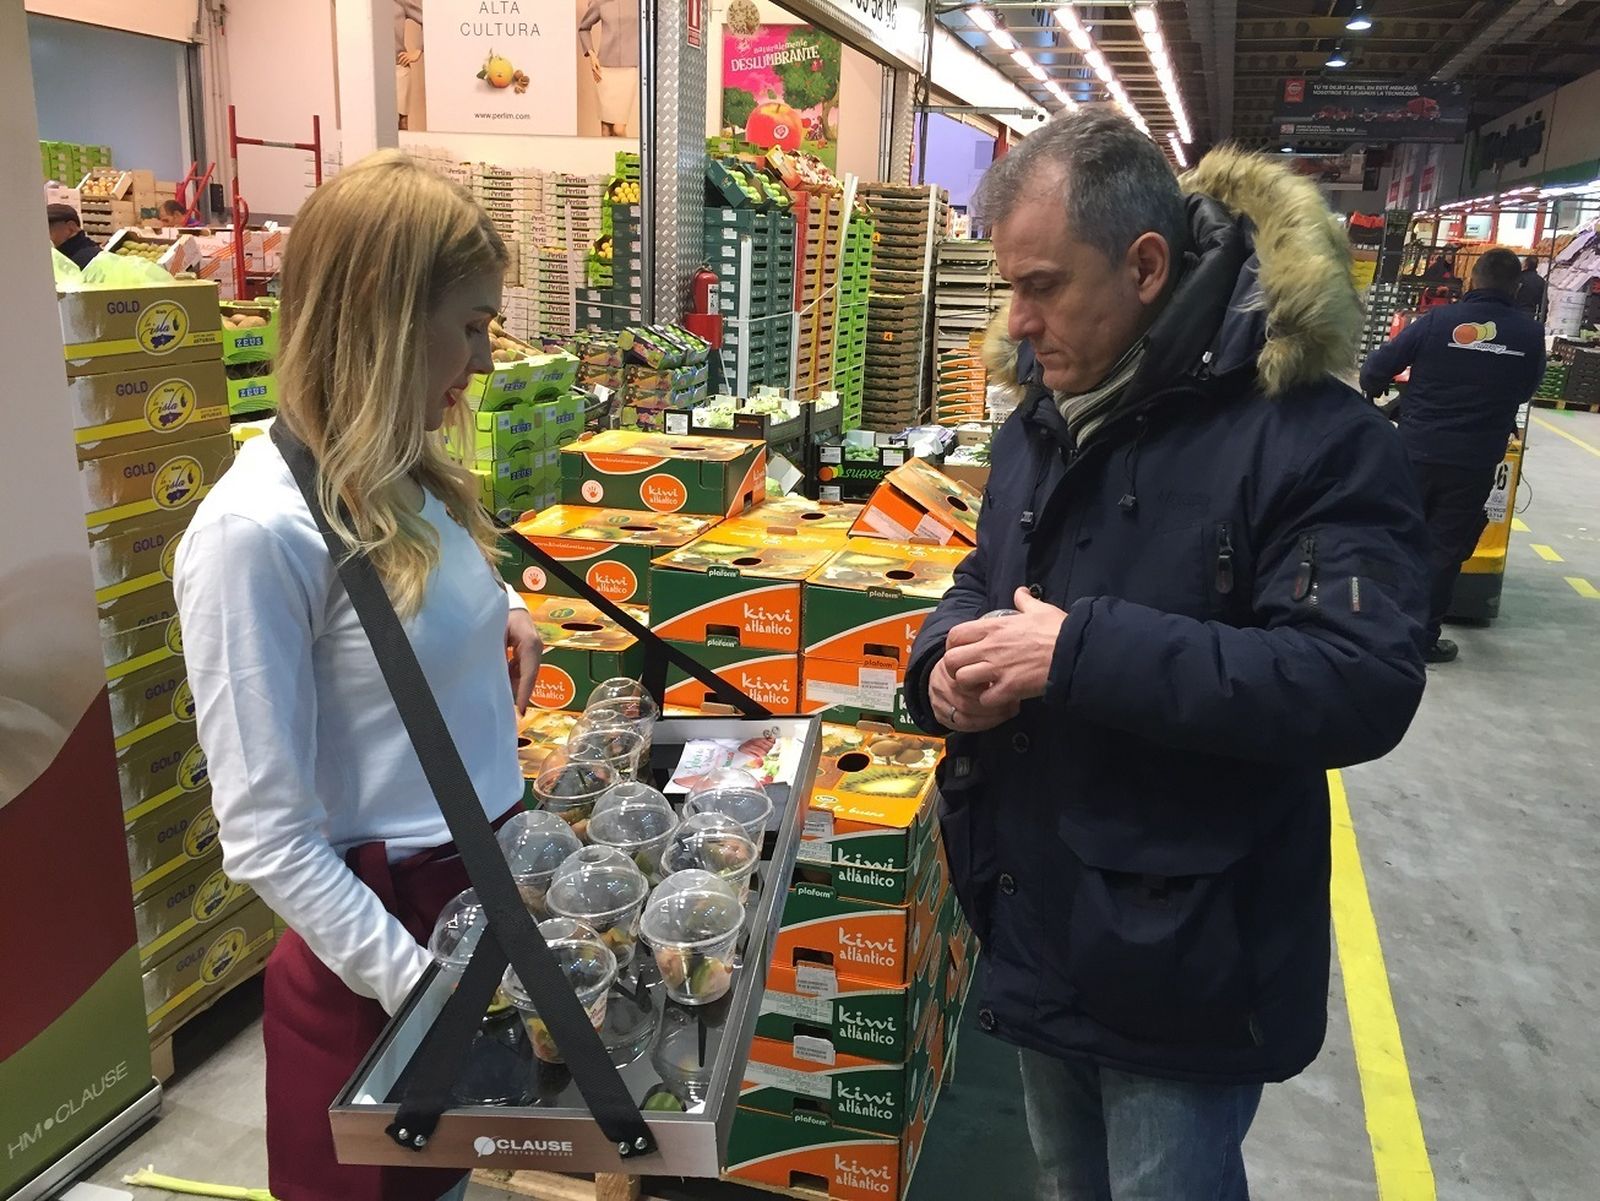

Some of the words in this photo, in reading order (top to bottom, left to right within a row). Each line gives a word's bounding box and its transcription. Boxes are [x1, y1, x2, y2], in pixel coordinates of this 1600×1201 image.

[478, 0, 521, 15] ALTA
[459, 22, 542, 37] CULTURA
[730, 45, 821, 72] DESLUMBRANTE
[474, 112, 531, 120] www.perlim.com
[106, 300, 141, 315] GOLD
[235, 336, 263, 348] ZEUS
[885, 332, 891, 340] 4
[115, 380, 149, 397] GOLD
[239, 385, 266, 398] ZEUS
[158, 400, 179, 414] isla
[123, 461, 156, 479] GOLD
[843, 468, 890, 480] SUARE
[165, 477, 186, 492] isla
[648, 483, 679, 497] kiwi
[132, 533, 165, 554] GOLD
[594, 571, 628, 587] kiwi
[708, 568, 736, 578] plaform
[868, 590, 898, 600] plaform
[743, 601, 794, 623] kiwi
[744, 621, 792, 636] atlántico
[144, 679, 177, 701] GOLD
[741, 671, 791, 692] kiwi
[745, 688, 790, 705] tlántico
[150, 750, 182, 774] GOLD
[156, 819, 189, 844] GOLD
[837, 847, 895, 871] kiwi
[837, 868, 895, 888] atlántico
[165, 883, 197, 909] GOLD
[798, 887, 830, 898] plaform
[838, 926, 897, 953] kiwi
[175, 945, 207, 973] GOLD
[838, 947, 895, 967] atlántico
[838, 1004, 897, 1032] kiwi
[838, 1024, 895, 1045] atlántico
[837, 1080, 896, 1106] kiwi
[838, 1100, 893, 1120] atlántico
[794, 1114, 826, 1126] plaform
[496, 1138, 573, 1152] CLAUSE
[834, 1153, 892, 1180] kiwi
[835, 1173, 890, 1194] atlántico
